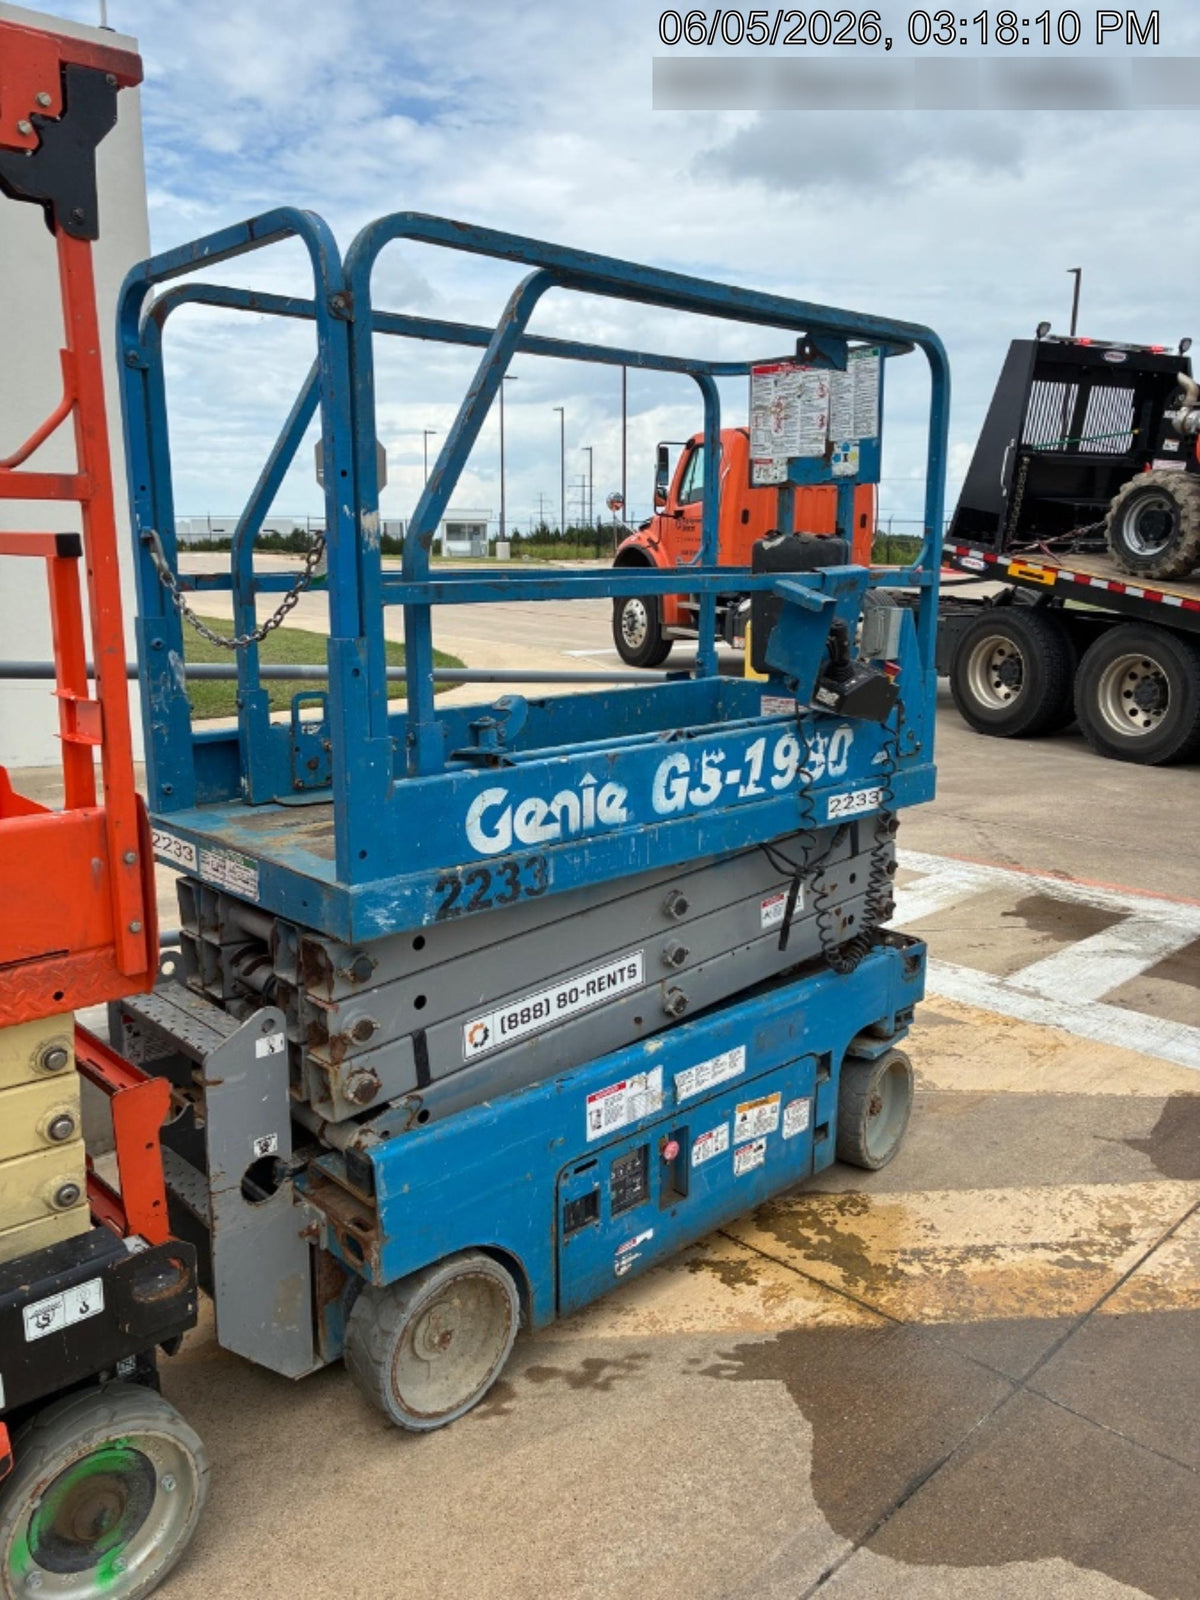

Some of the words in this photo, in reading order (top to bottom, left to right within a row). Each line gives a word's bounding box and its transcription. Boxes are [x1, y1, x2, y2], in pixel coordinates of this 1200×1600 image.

[829, 790, 880, 813] 2233
[152, 831, 194, 863] 2233
[435, 855, 549, 921] 2233
[500, 998, 550, 1035] (888)
[557, 963, 637, 1009] 80-RENTS
